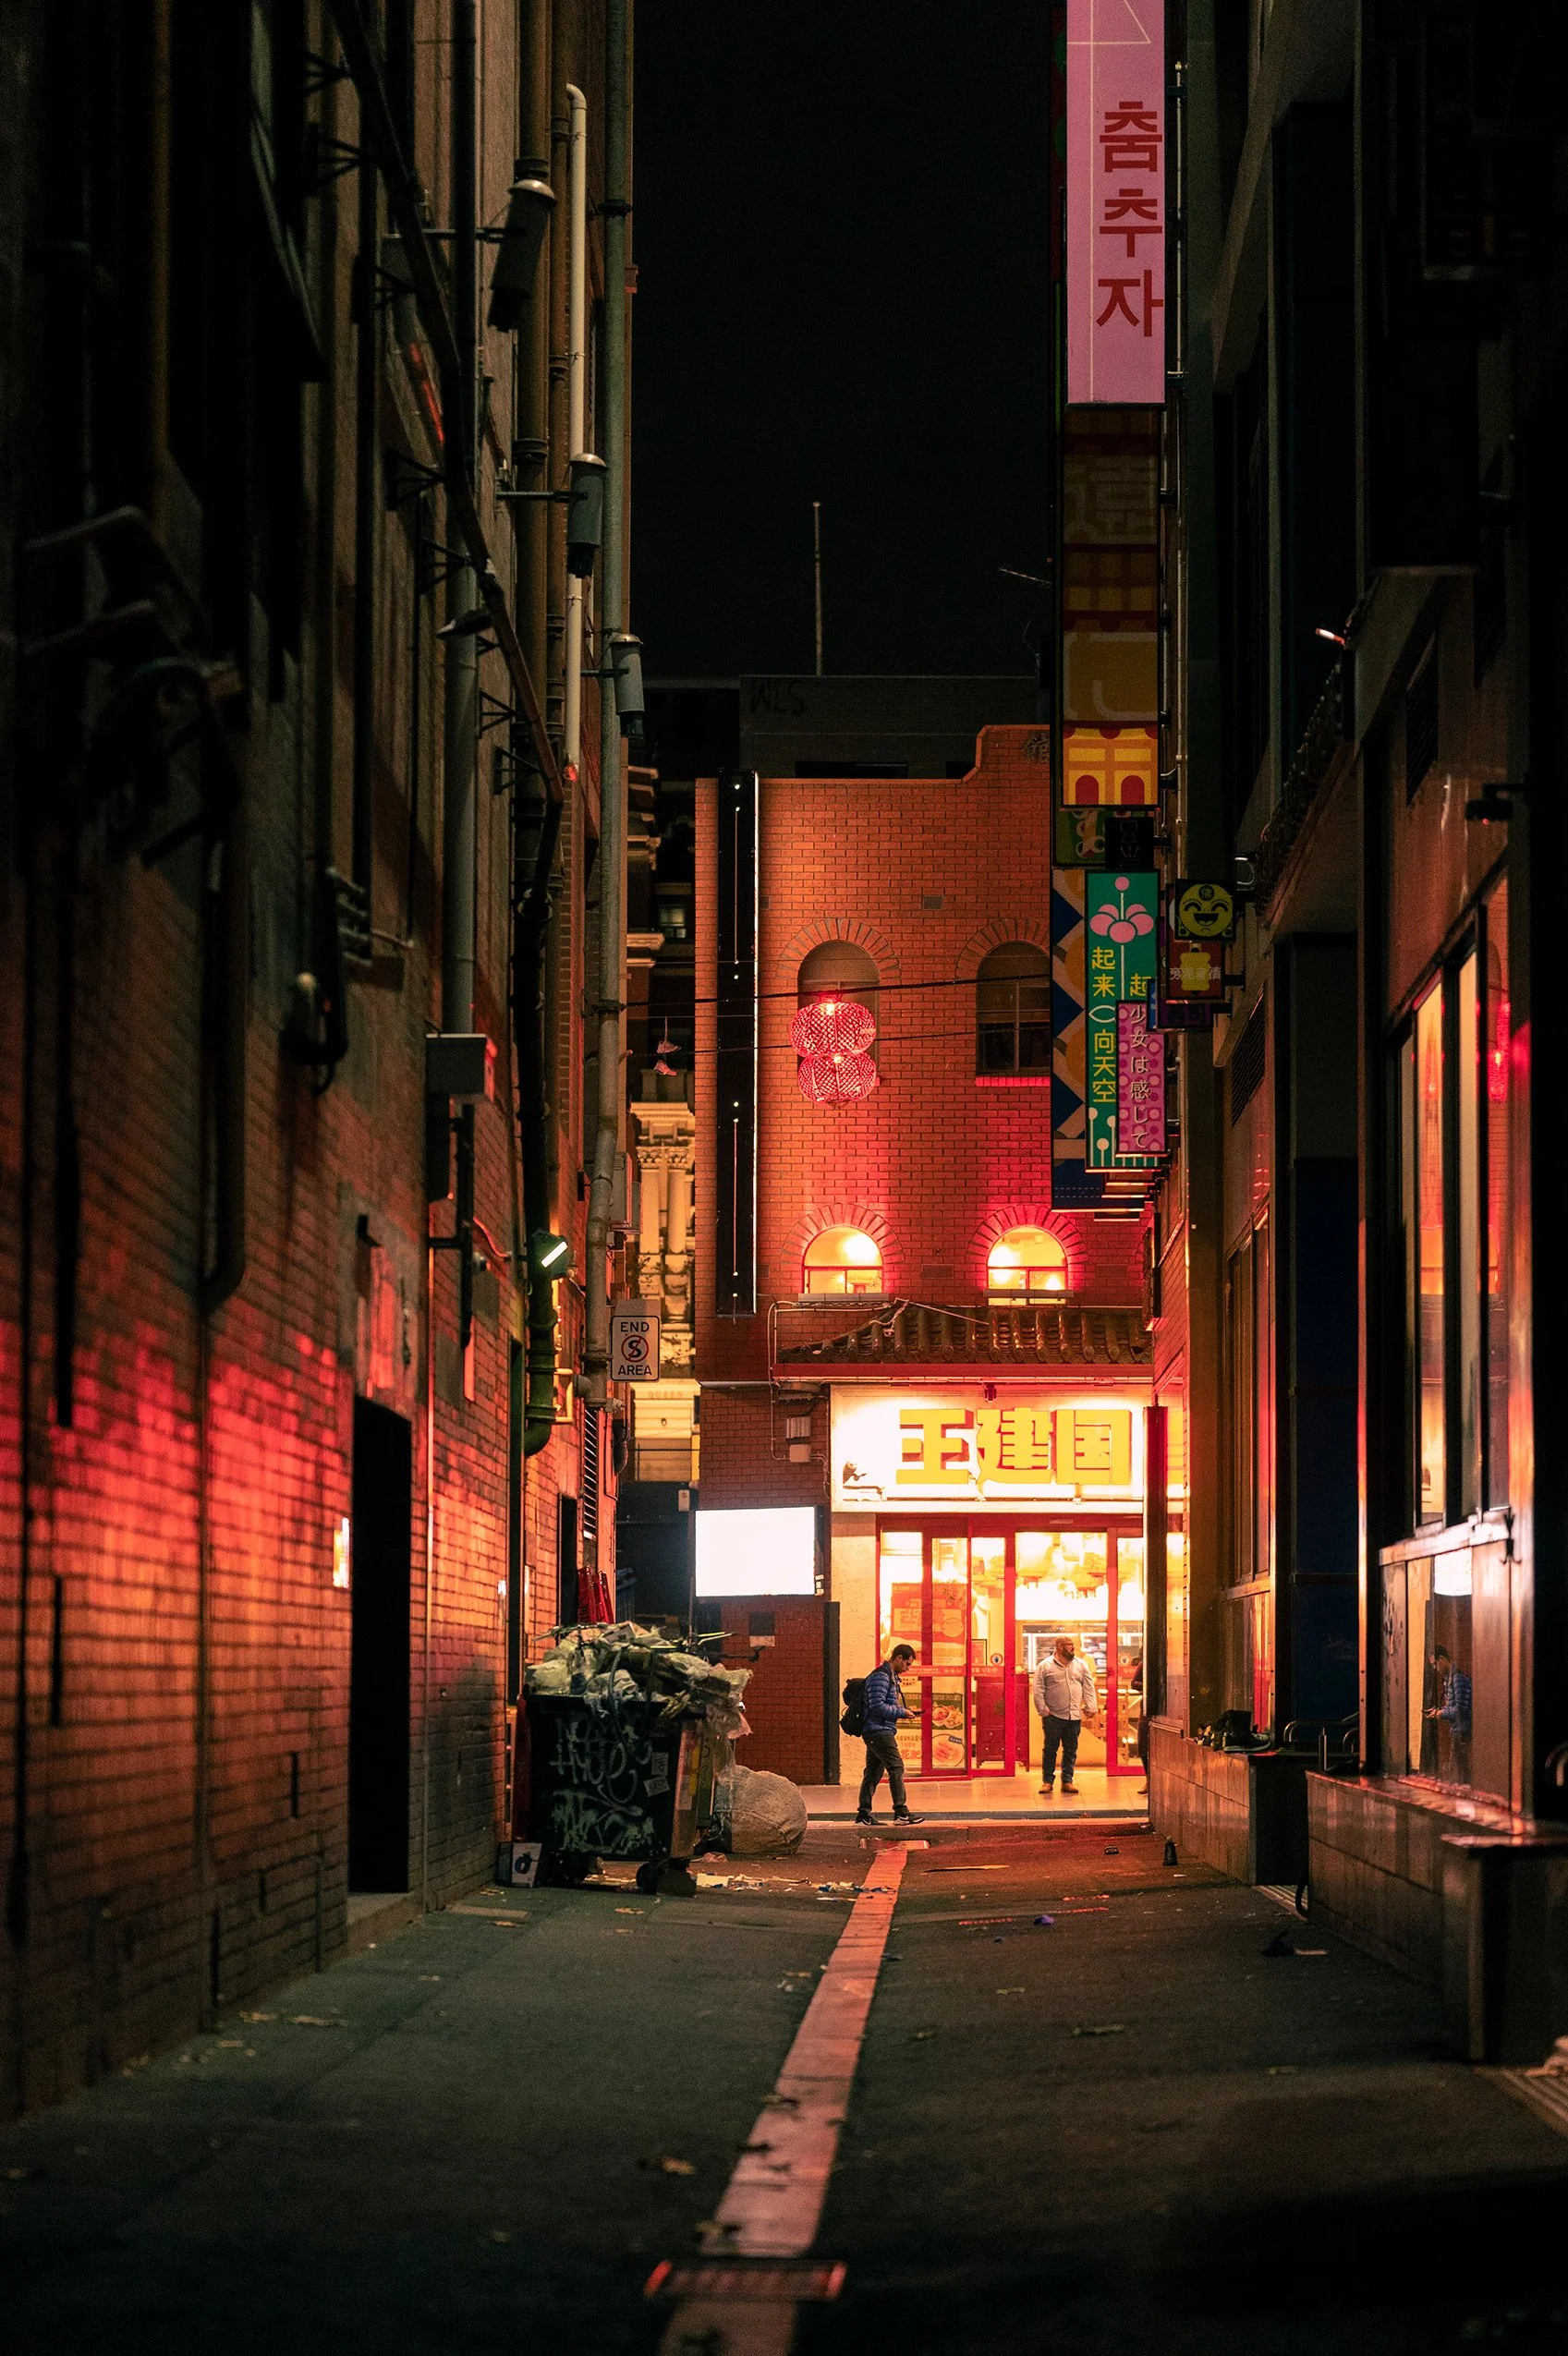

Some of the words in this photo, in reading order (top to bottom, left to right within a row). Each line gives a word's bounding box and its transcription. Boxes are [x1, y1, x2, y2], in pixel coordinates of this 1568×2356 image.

[1096, 101, 1164, 336] 춤추자
[1091, 945, 1116, 998] 起来
[1129, 973, 1152, 997] 起
[1092, 1028, 1116, 1103] 向天空
[1130, 1004, 1150, 1149] 少女は感じて
[620, 1321, 650, 1332] END
[617, 1365, 652, 1376] AREA
[895, 1406, 1133, 1486] 王建国
